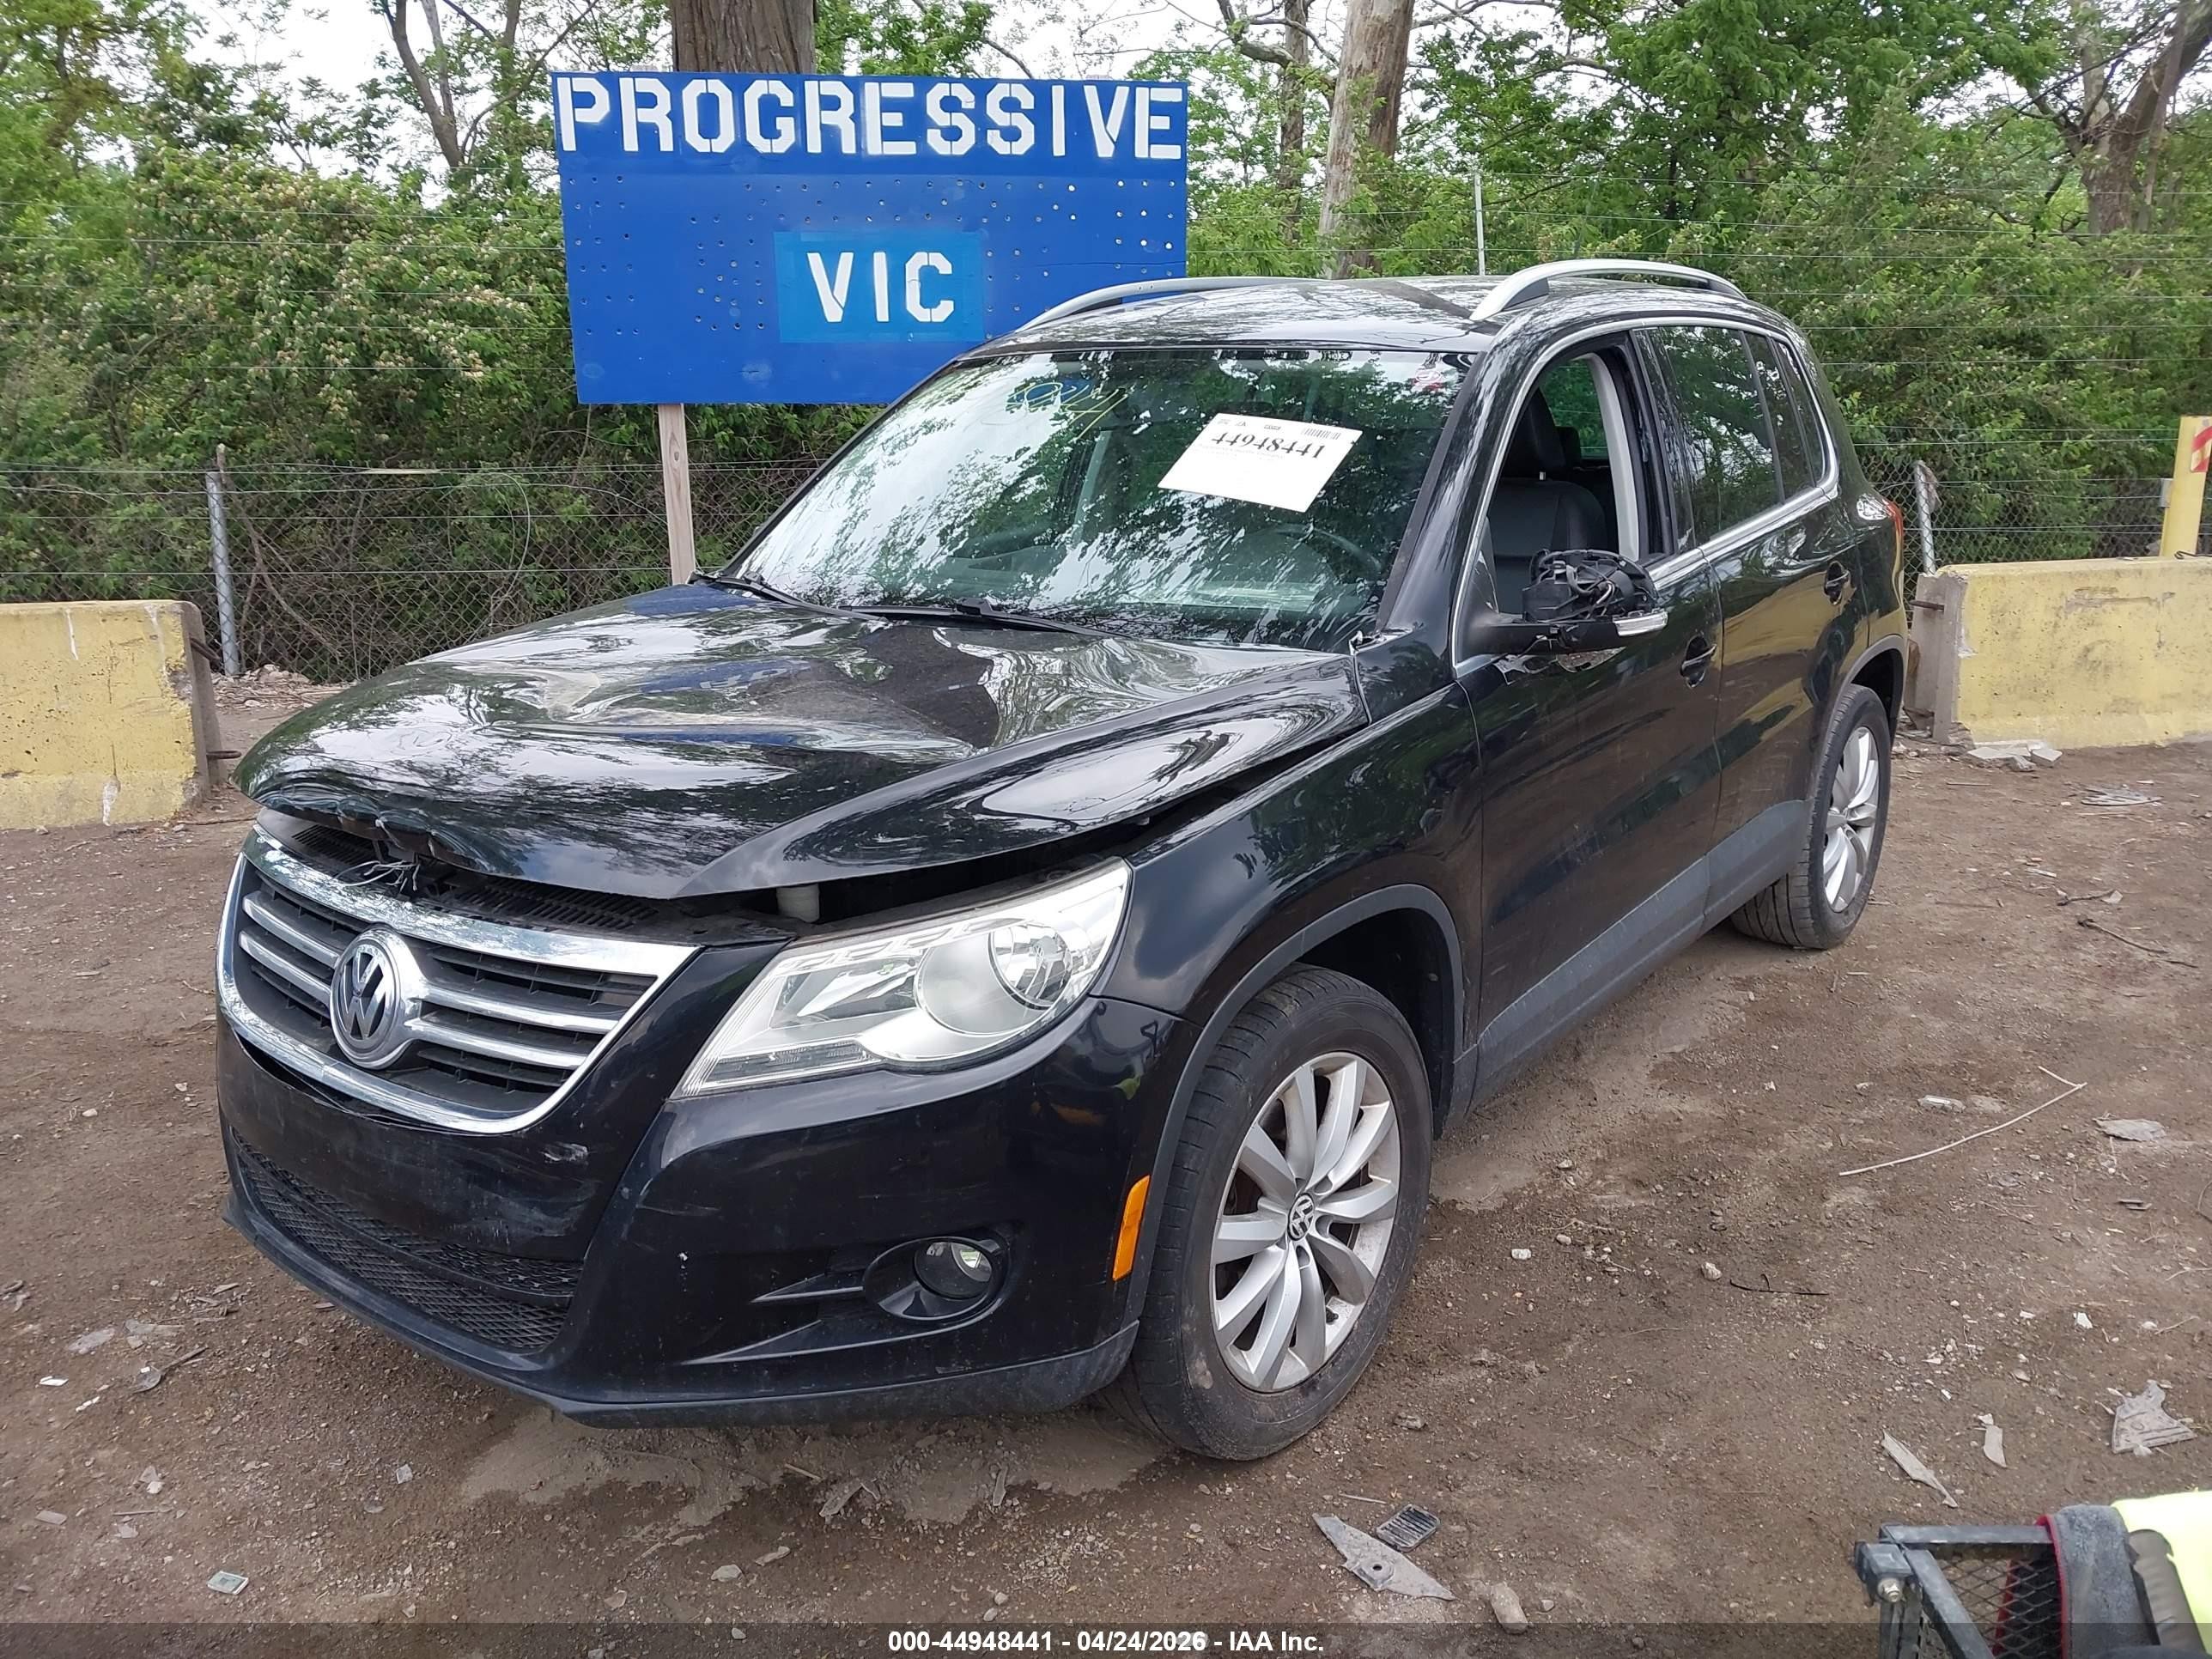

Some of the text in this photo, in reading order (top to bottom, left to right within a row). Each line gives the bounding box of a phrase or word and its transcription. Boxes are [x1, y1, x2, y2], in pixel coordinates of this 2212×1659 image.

[556, 76, 1183, 161] PROGRESSIVE
[806, 251, 954, 323] VIC
[1211, 431, 1327, 459] 44948441
